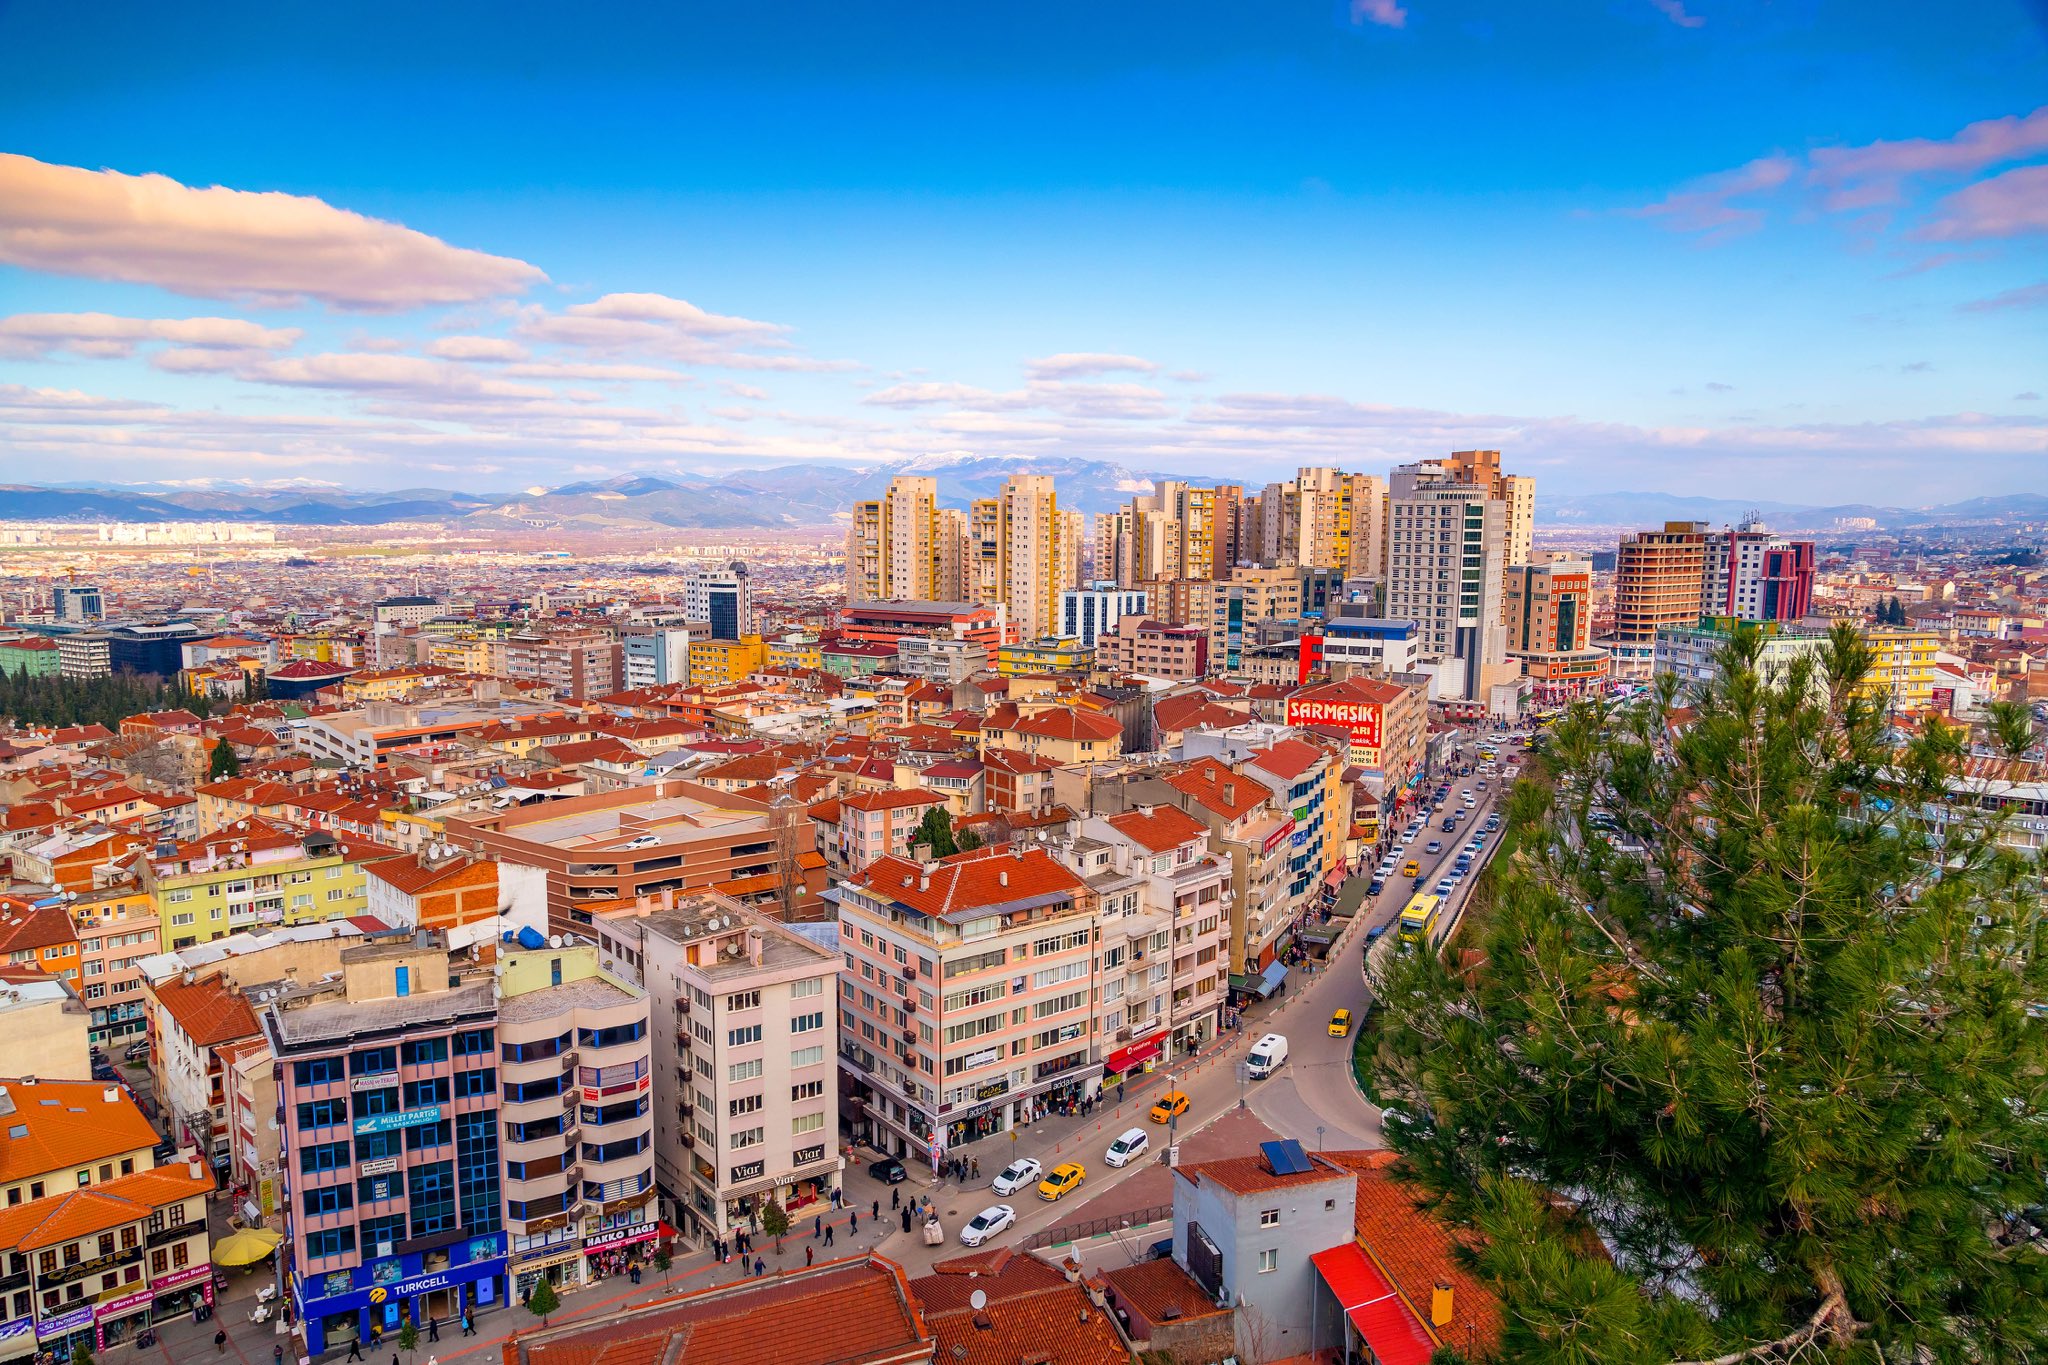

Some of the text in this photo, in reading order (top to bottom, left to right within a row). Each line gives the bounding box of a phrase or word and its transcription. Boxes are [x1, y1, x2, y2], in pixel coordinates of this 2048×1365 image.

[1290, 702, 1374, 723] SARMAŞIK
[1053, 1076, 1075, 1092] addax
[968, 1104, 992, 1119] addax
[797, 1147, 821, 1161] Viar
[735, 1163, 760, 1178] Viar
[774, 1174, 796, 1187] Viar
[586, 1222, 656, 1247] HAKKO BAGS
[546, 1254, 578, 1265] TELEKOM
[167, 1265, 210, 1283] Merve Butik
[394, 1275, 449, 1296] TURKCELL
[112, 1292, 154, 1310] Merve Butik
